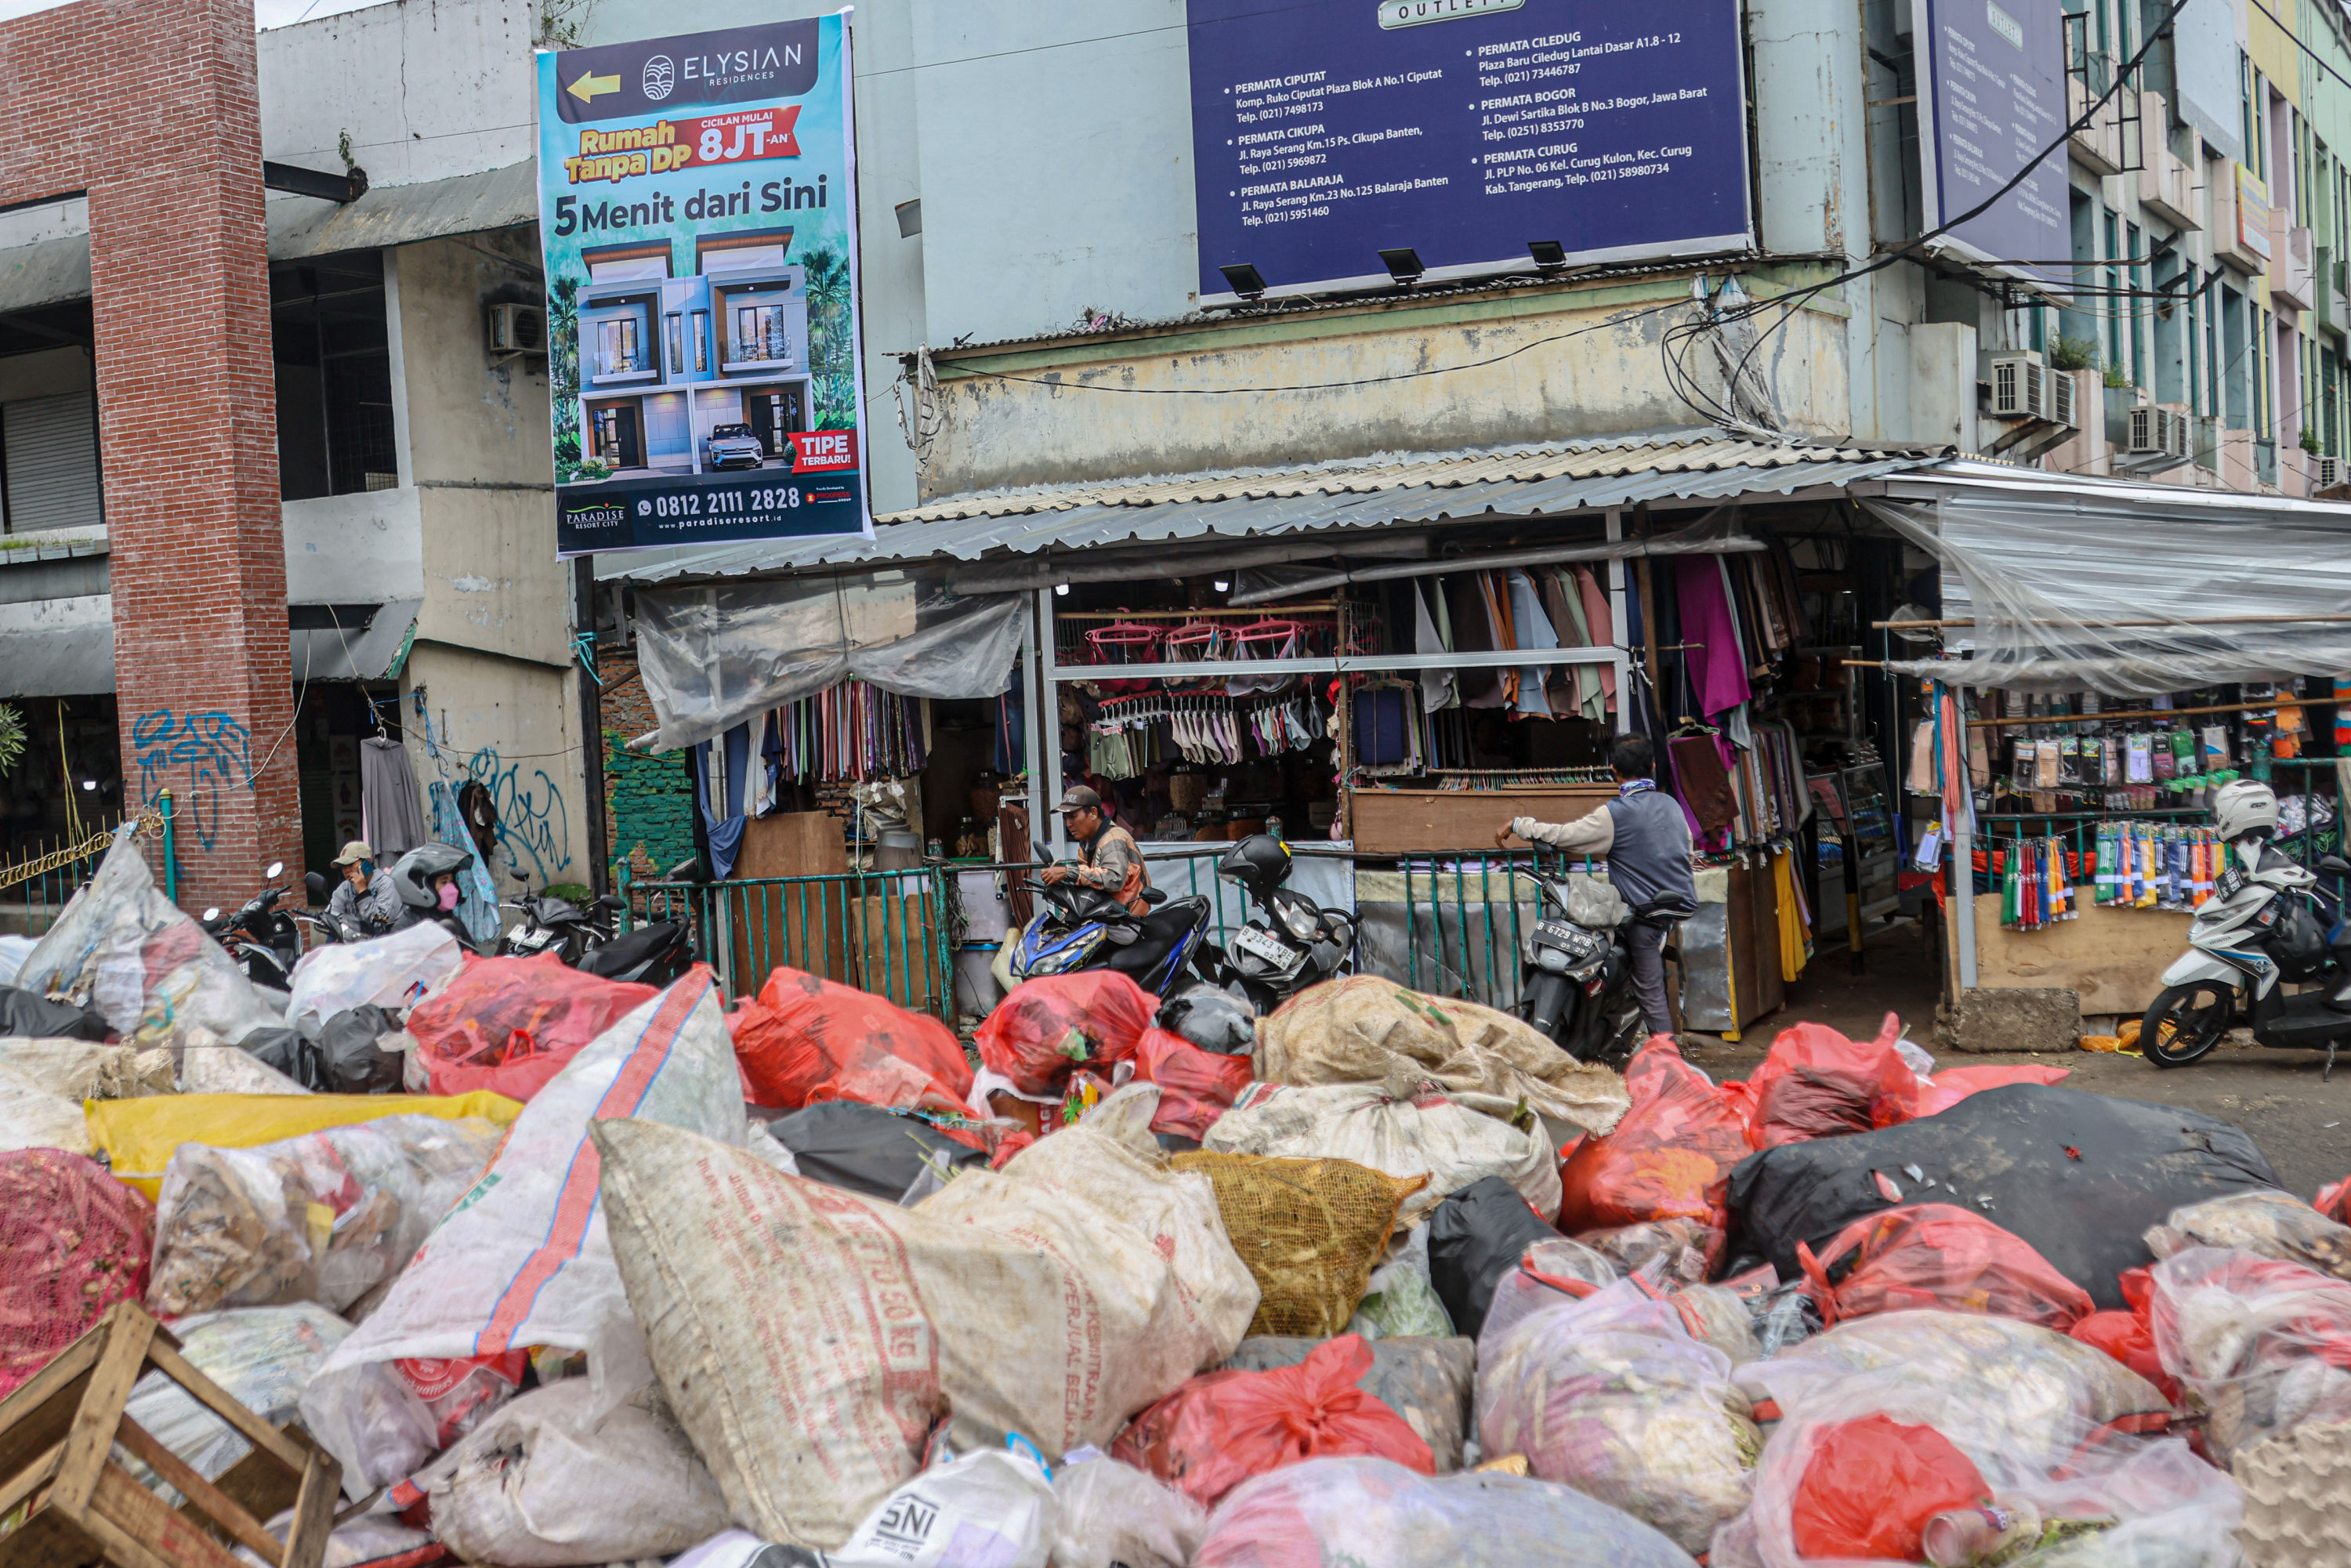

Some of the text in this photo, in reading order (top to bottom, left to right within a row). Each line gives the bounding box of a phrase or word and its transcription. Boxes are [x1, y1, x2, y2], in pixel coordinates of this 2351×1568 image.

[1478, 31, 1581, 56] PERMATA CILEDUG
[1480, 60, 1505, 71] Plaza
[1507, 55, 1530, 67] Baru
[1532, 49, 1570, 66] Ciledug
[1572, 44, 1603, 57] Lantai
[1605, 41, 1634, 53] Dasar
[1636, 36, 1659, 49] A1.8
[1668, 33, 1681, 44] 12
[684, 43, 801, 80] ELYSIAN
[709, 71, 774, 86] RESIDENCES
[1235, 71, 1326, 94] PERMATA CIPUTAT
[1480, 63, 1581, 88] Telp. (021) 73446787
[1236, 68, 1442, 110] Komp. Ruko Ciputat Plaza Blok A No.1 Ciputat
[1481, 88, 1576, 110] PERMATA BOGOR
[1237, 102, 1324, 124] Telp. (021) 7498173
[1482, 87, 1708, 125] Jl. Dewi Sartika Blok B No.3 Bogor, Jawa Barat
[701, 110, 773, 129] CICILAN MULAI
[1483, 119, 1584, 143] Telp. (0251) 8353770
[581, 121, 676, 155] Rumah
[1238, 124, 1325, 145] PERMATA CIKUPA
[1239, 126, 1422, 161] Jl. Raya Serang Km.15 Ps. Cikupa Banten,
[565, 143, 692, 184] Tanpa DP
[1240, 154, 1327, 176] Telp. (021) 5969872
[1483, 143, 1578, 164] PERMATA CURUG
[1484, 145, 1692, 180] Jl. PLP No. 06 Kel. Curug Kulon, Kec. Curug
[1241, 174, 1344, 197] PERMATA BALARAJA
[1486, 162, 1669, 195] Kab. Tangerang, Telp. (021) 58980734
[554, 174, 827, 237] 5 Menit dari Sini
[1242, 176, 1448, 212] Jl. Raya Serang Km.23 No.125 Balaraja Banten
[1242, 206, 1329, 227] Telp. (021) 5951460
[801, 435, 849, 454] TIPE
[802, 451, 851, 466] TERBARU!
[656, 487, 799, 517] 0812 2111 2828
[566, 510, 625, 523] PARADISE
[575, 521, 600, 530] RESORT
[658, 514, 781, 530] www.paradiseresort.id
[1242, 928, 1250, 936] B
[1537, 922, 1545, 931] B
[1548, 925, 1571, 940] 6729
[2209, 936, 2233, 946] HONDA
[878, 1291, 916, 1322] 50
[1084, 1311, 1102, 1422] KEMITRAAN
[879, 1501, 937, 1538] SNI
